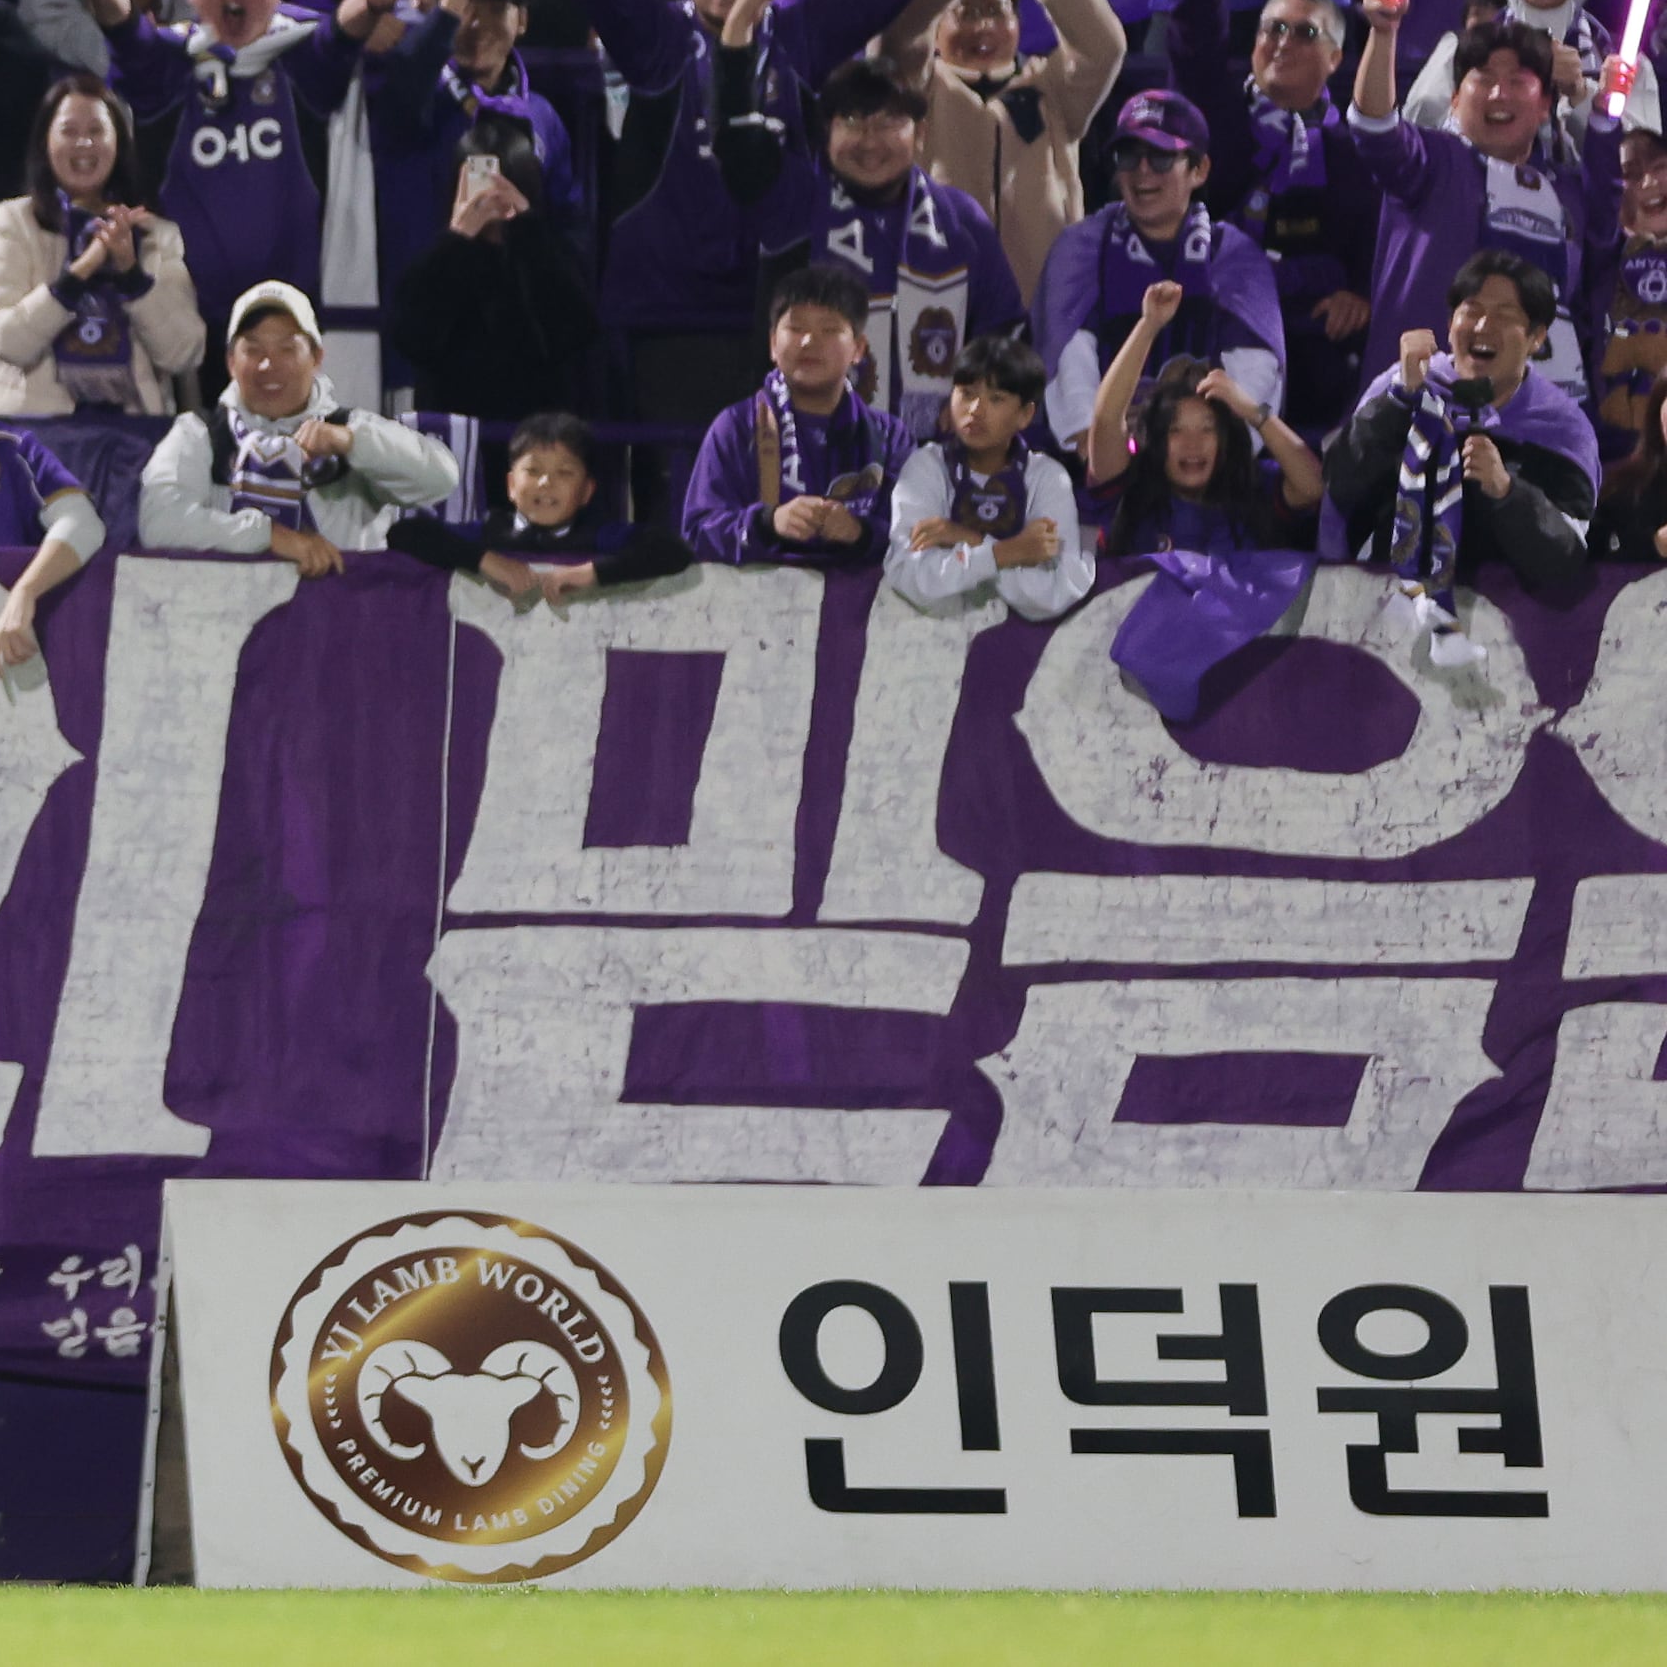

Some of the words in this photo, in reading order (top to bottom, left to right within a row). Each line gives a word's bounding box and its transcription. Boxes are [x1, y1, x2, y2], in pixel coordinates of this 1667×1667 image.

[424, 562, 1667, 1191] 믿음
[46, 1242, 159, 1302] 우리
[320, 1320, 365, 1364] YJ
[347, 1255, 462, 1324] LAMB
[475, 1256, 607, 1366] WORLD
[40, 1306, 159, 1359] 믿음
[777, 1278, 1551, 1520] 인덕원
[336, 1437, 444, 1527] PREMIUM
[453, 1508, 531, 1532] LAMB
[536, 1439, 608, 1517] DINING
